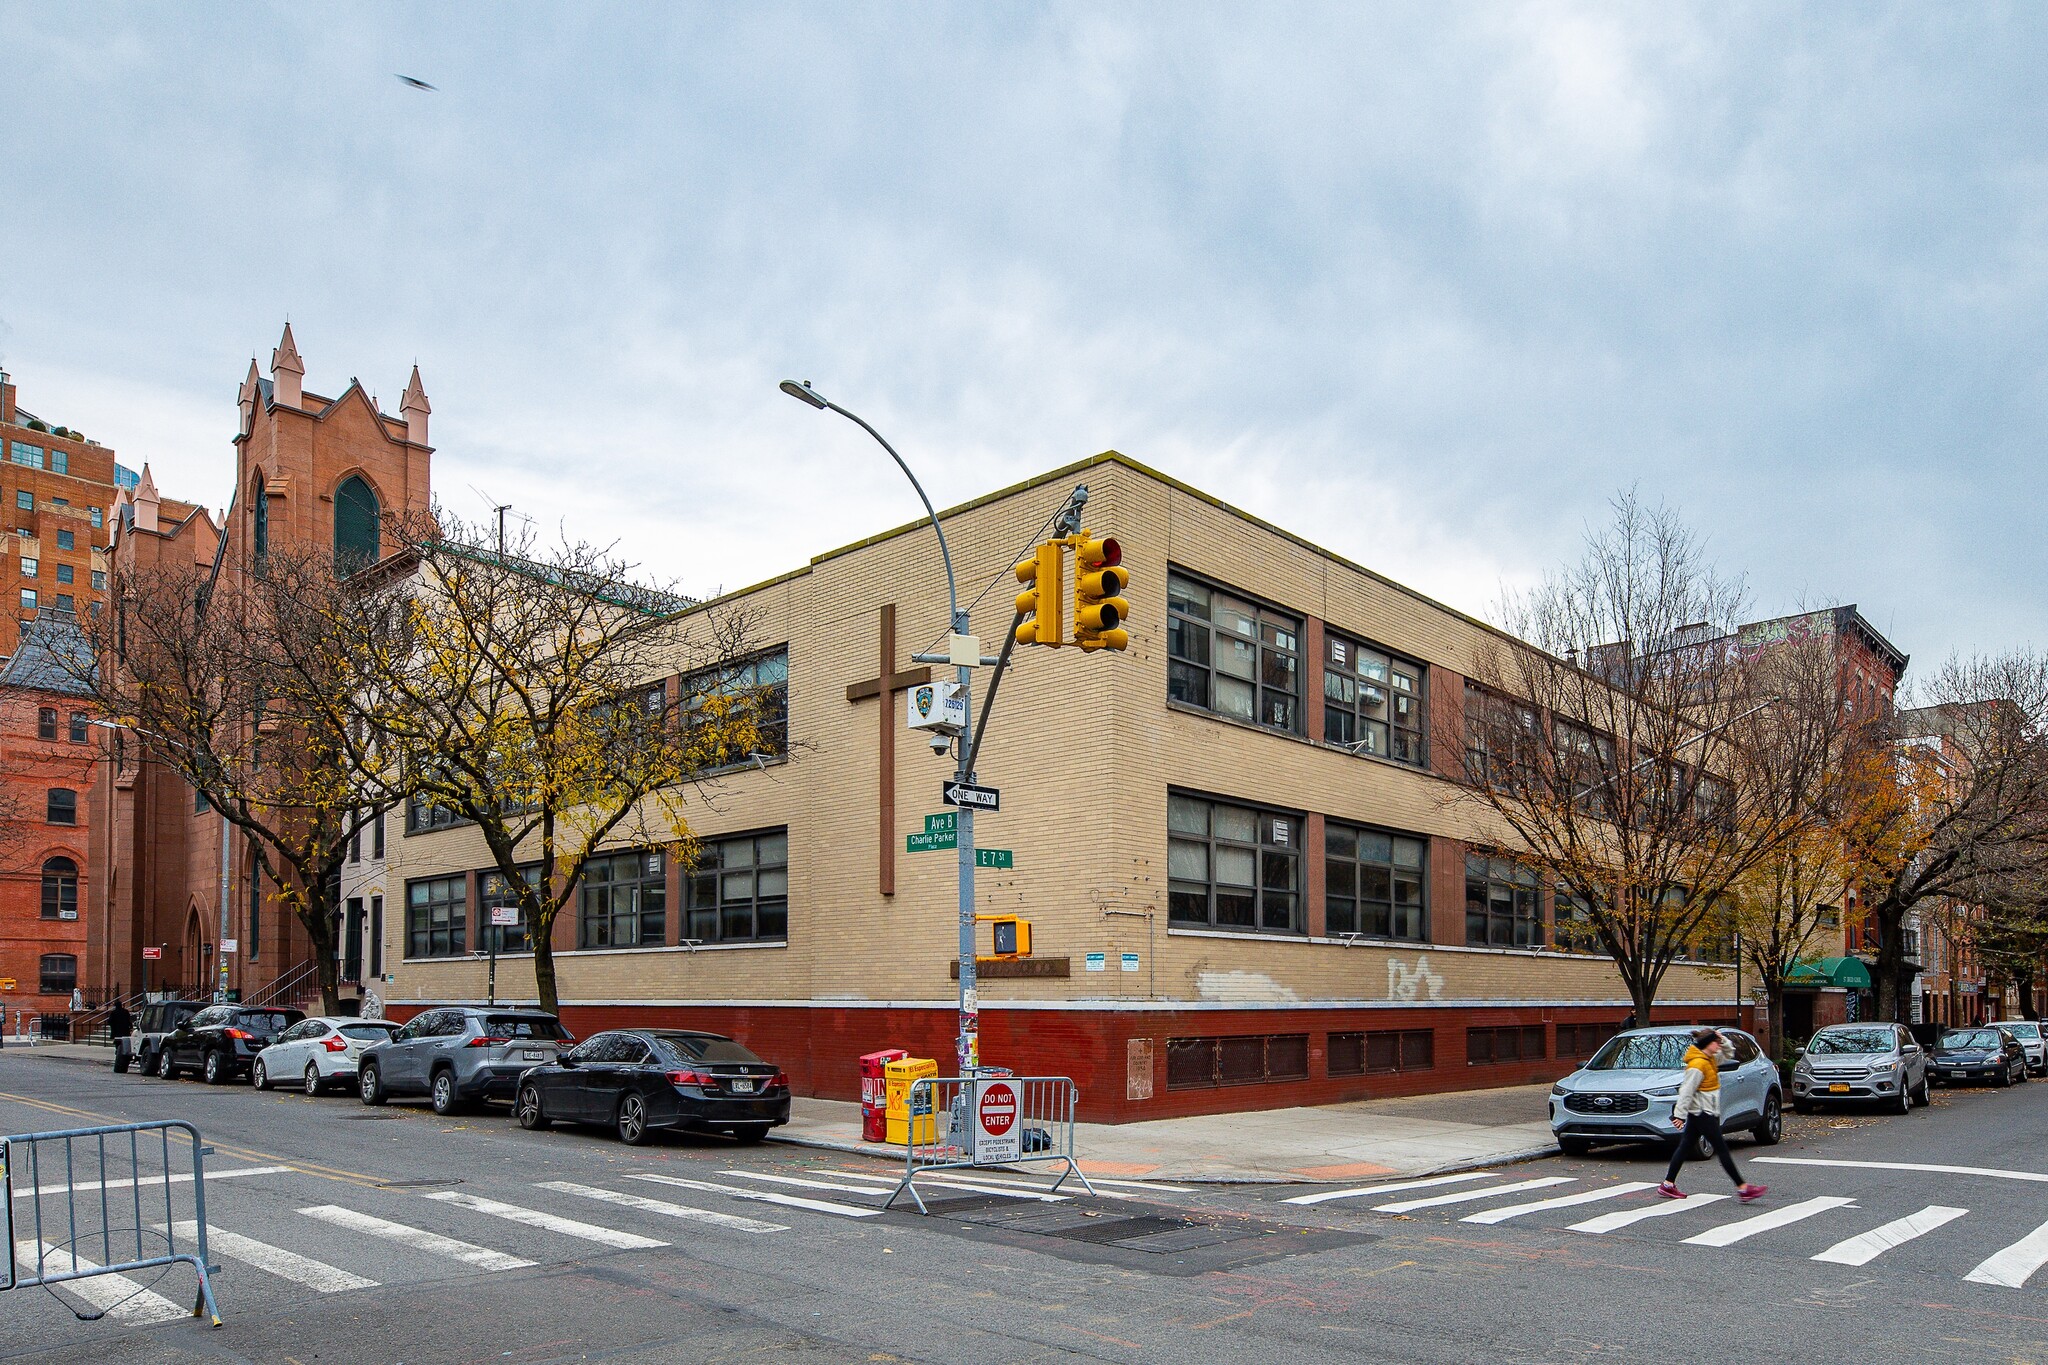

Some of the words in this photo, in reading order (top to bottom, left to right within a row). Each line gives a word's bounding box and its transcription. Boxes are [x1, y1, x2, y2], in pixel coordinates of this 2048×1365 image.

[951, 789, 969, 801] ONE
[975, 792, 993, 804] WAY
[931, 816, 945, 830] Ave
[947, 814, 953, 828] B
[910, 834, 932, 845] Charlie
[934, 832, 955, 843] Parker
[982, 851, 988, 865] E
[991, 852, 996, 865] 7
[998, 852, 1005, 861] St
[984, 1094, 995, 1103] DO
[997, 1093, 1013, 1103] NOT
[985, 1115, 1010, 1126] ENTER
